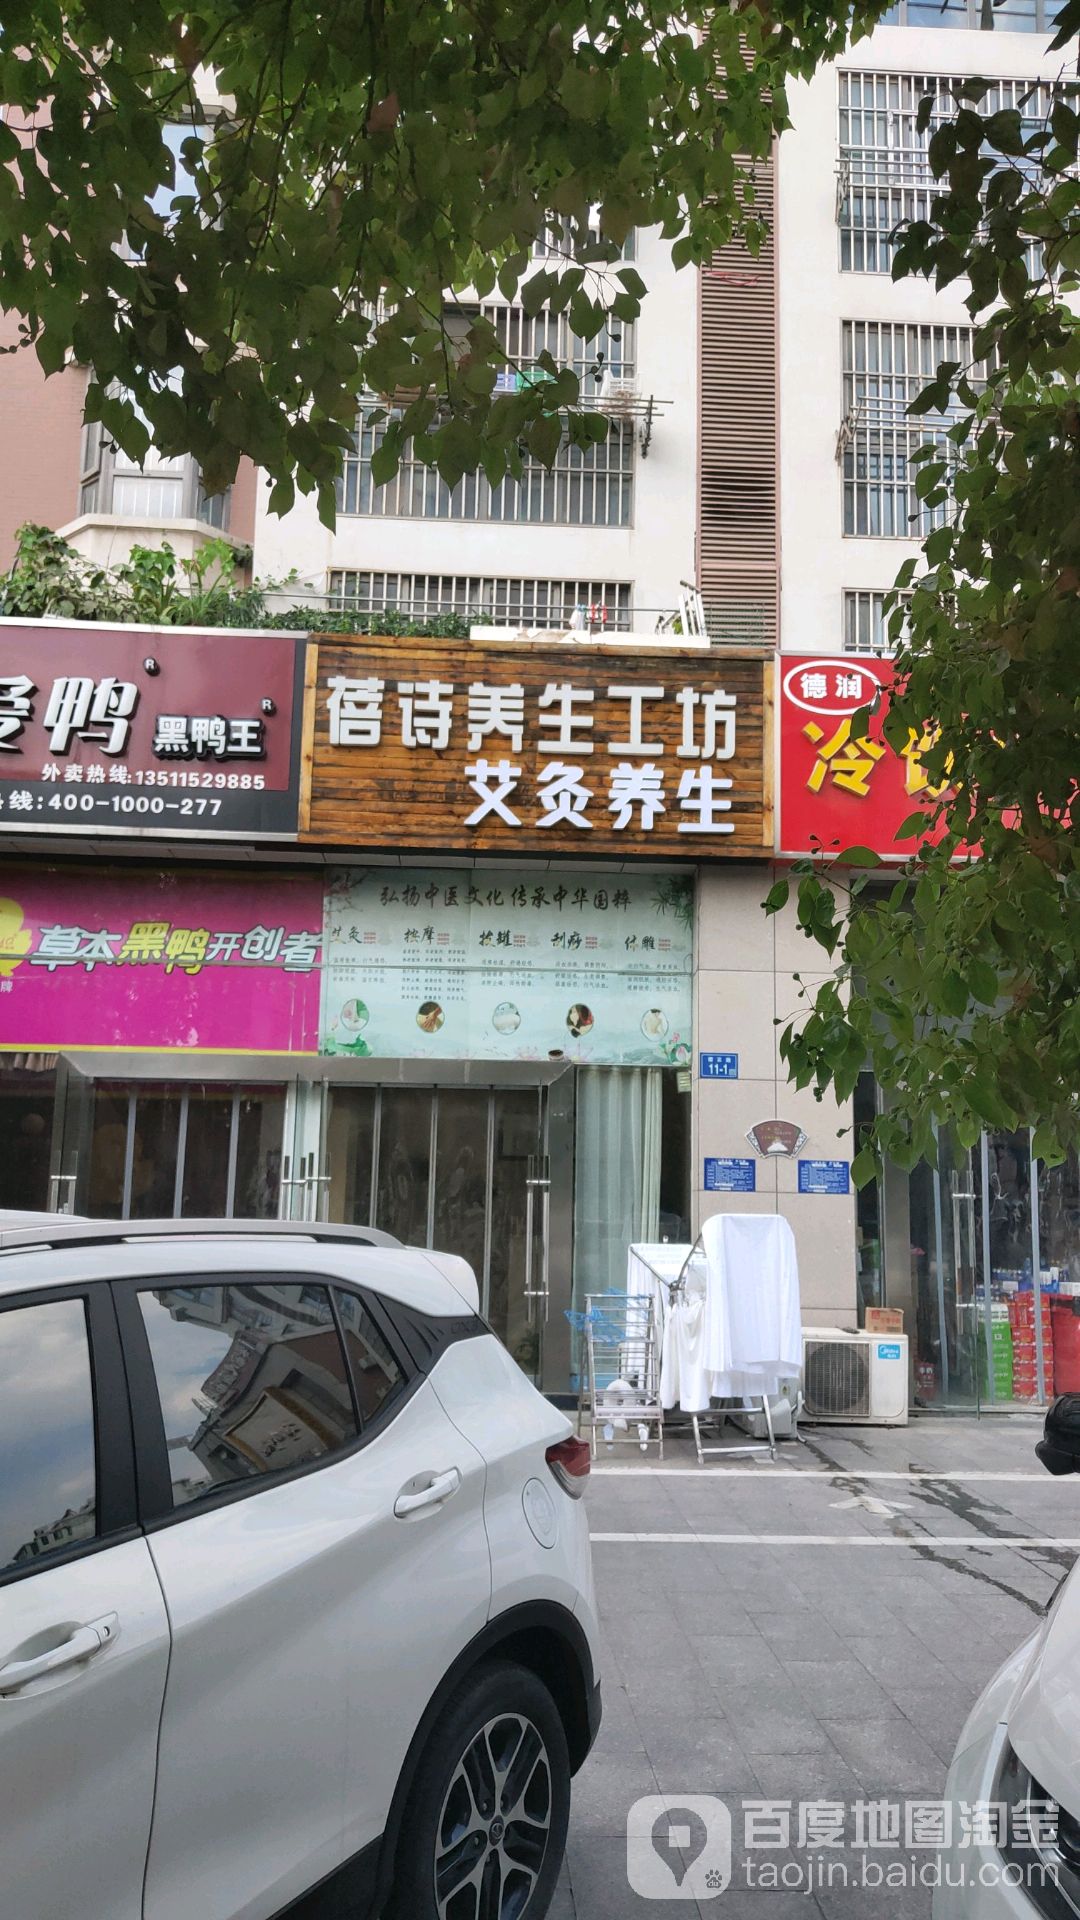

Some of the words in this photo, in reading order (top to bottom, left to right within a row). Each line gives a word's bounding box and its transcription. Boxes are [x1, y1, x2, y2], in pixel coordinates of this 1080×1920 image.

[800, 672, 863, 700] 德润
[155, 716, 262, 754] 黑鸭王
[327, 676, 737, 760] 蓓诗养生工坊
[0, 790, 222, 816] 线:400-1000-277
[463, 758, 736, 834] 艾灸养生
[30, 921, 322, 975] 草本黑鸭开创者
[708, 1064, 728, 1075] 11-1
